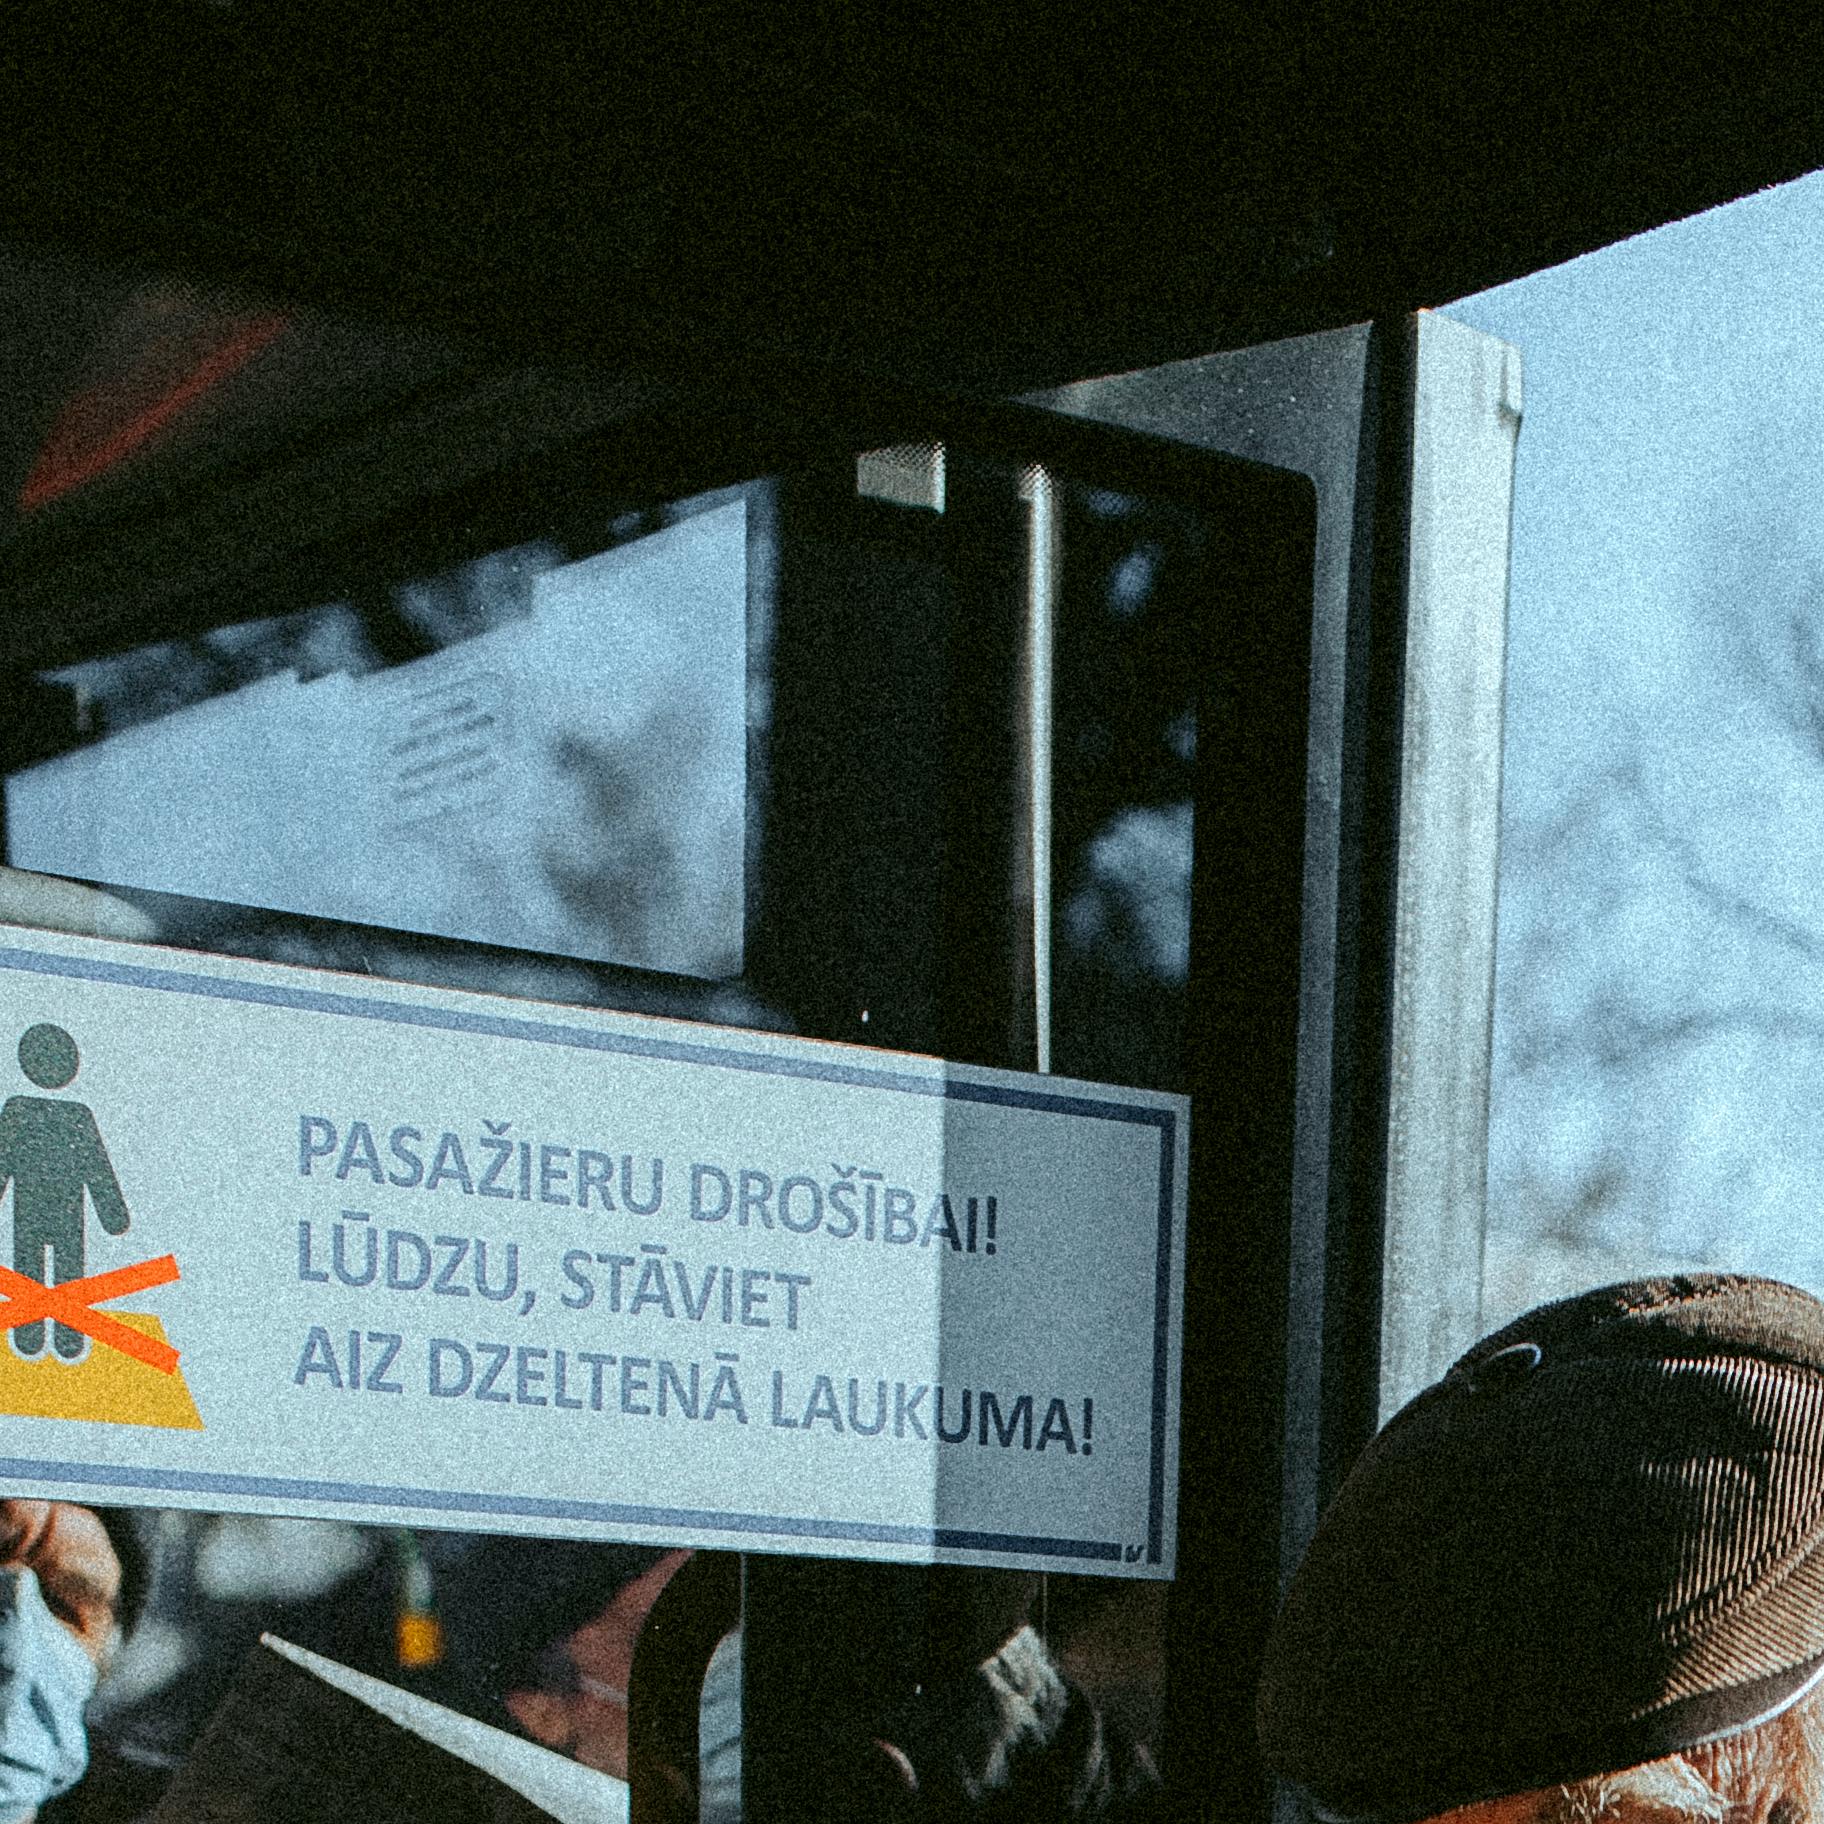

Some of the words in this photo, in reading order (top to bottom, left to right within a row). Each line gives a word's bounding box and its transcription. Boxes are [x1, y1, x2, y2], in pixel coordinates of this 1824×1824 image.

[299, 1114, 664, 1216] PASAŽIERU
[690, 1162, 998, 1257] DROŠĪBAI!
[298, 1209, 537, 1316] LŪDZU,
[560, 1243, 812, 1331] STĀVIET
[293, 1325, 404, 1394] AIZ
[428, 1337, 749, 1425] DZELTENĀ
[771, 1369, 1094, 1456] LAUKUMA!
